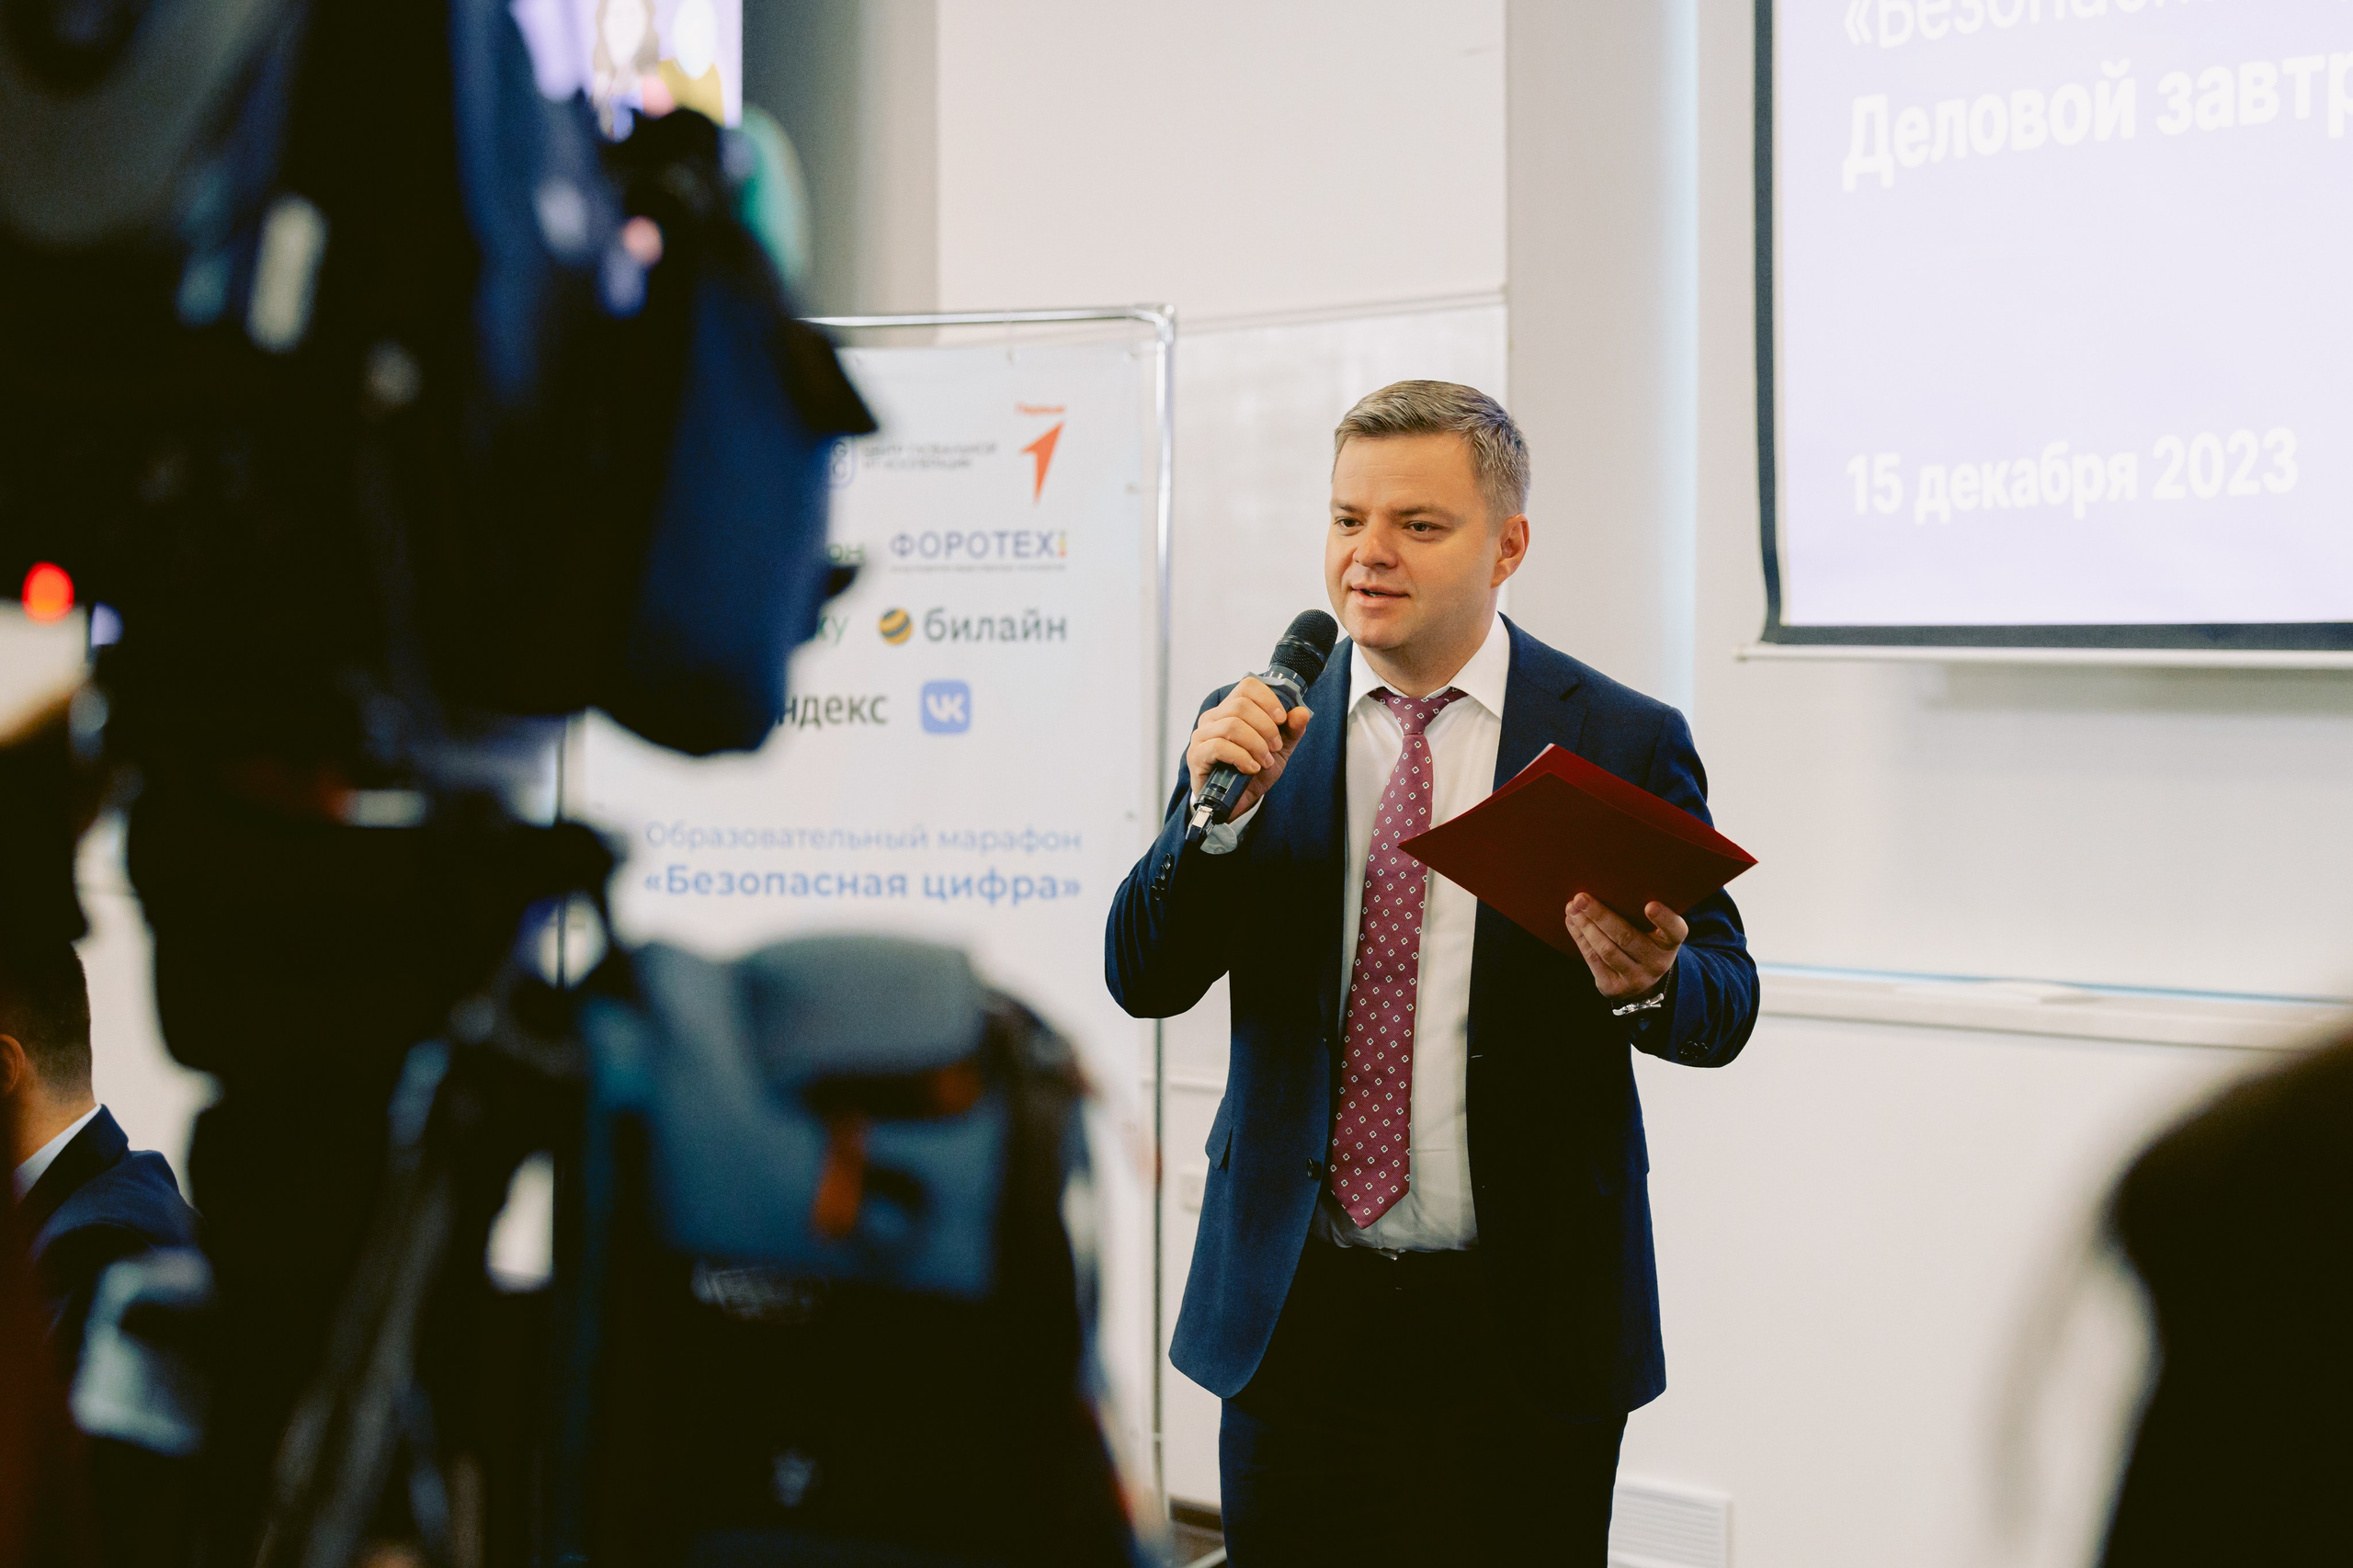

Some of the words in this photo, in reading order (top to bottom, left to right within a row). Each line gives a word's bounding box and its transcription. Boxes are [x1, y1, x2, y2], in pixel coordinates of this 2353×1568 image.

[1841, 58, 2138, 192] Деловой
[1846, 451, 1904, 515] 15
[1914, 440, 2139, 525] декабря
[2152, 426, 2300, 500] 2023
[924, 608, 1068, 642] билайн
[926, 693, 965, 722] VK
[645, 821, 929, 852] Образовательный
[938, 824, 1083, 855] марафон
[644, 863, 909, 899] «Безопасная
[923, 867, 1082, 907] цифра»
